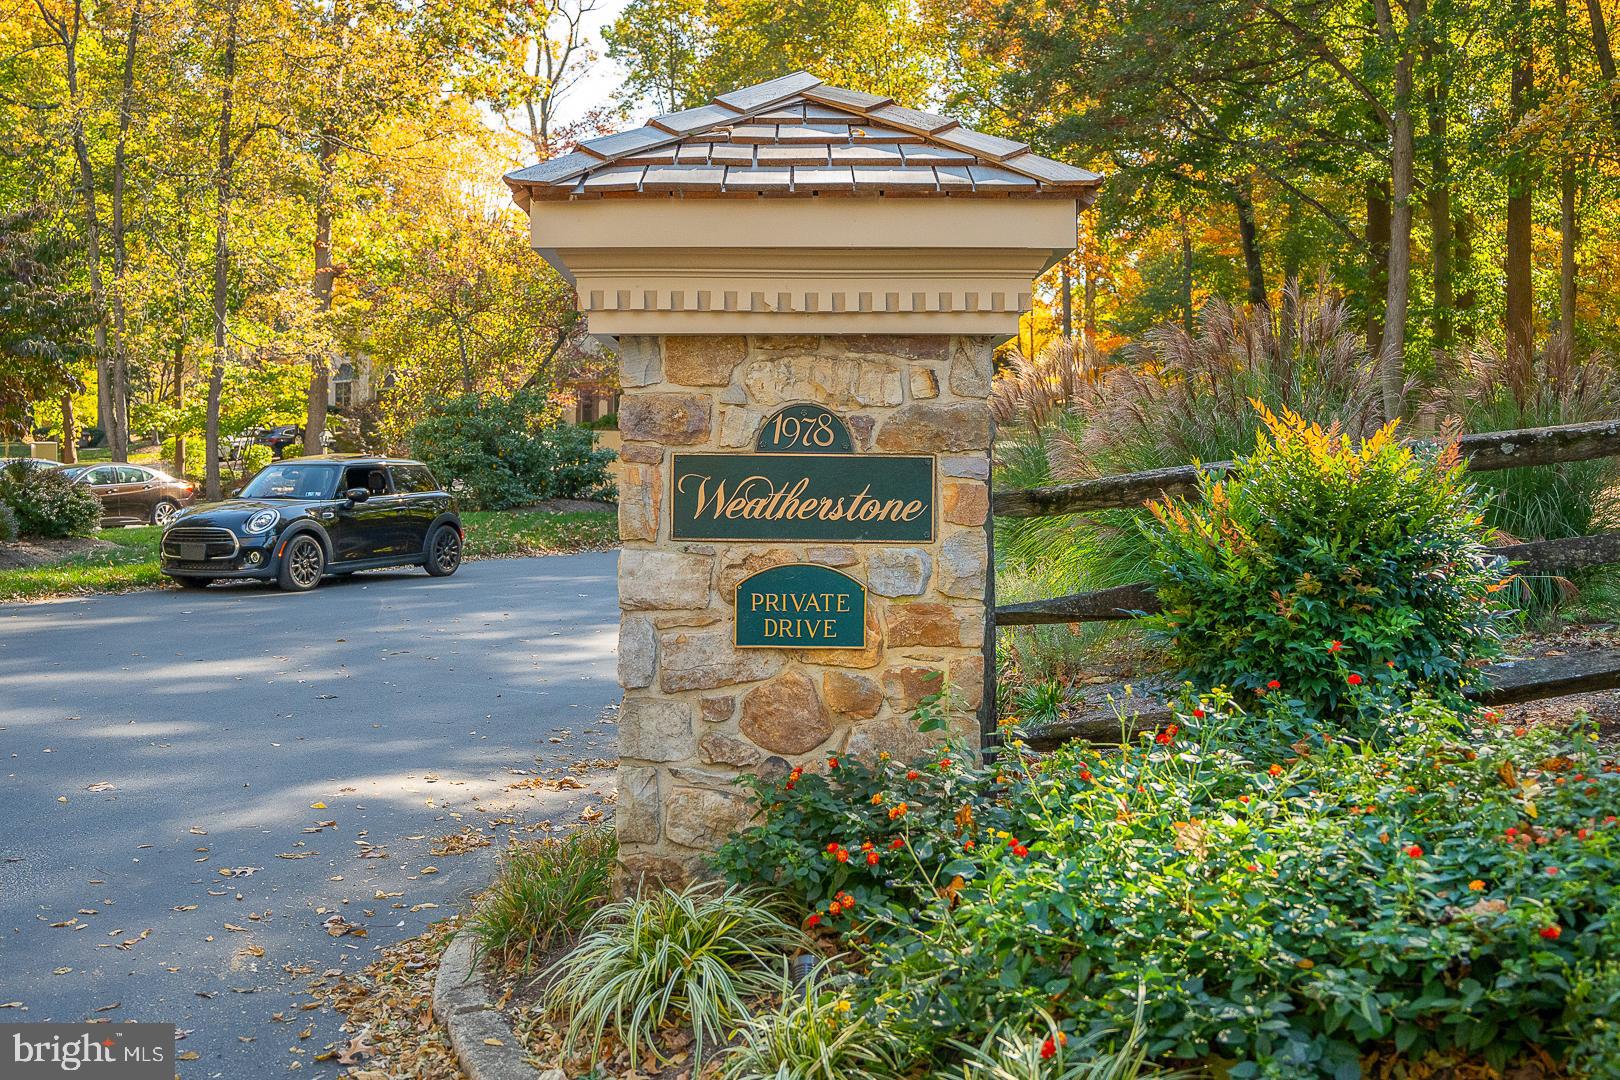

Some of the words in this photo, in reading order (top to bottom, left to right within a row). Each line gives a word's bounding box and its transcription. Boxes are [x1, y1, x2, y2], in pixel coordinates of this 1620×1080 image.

[772, 413, 835, 449] 1978
[677, 473, 929, 522] Weatherstone
[751, 593, 850, 612] PRIVATE
[763, 618, 837, 639] DRIVE
